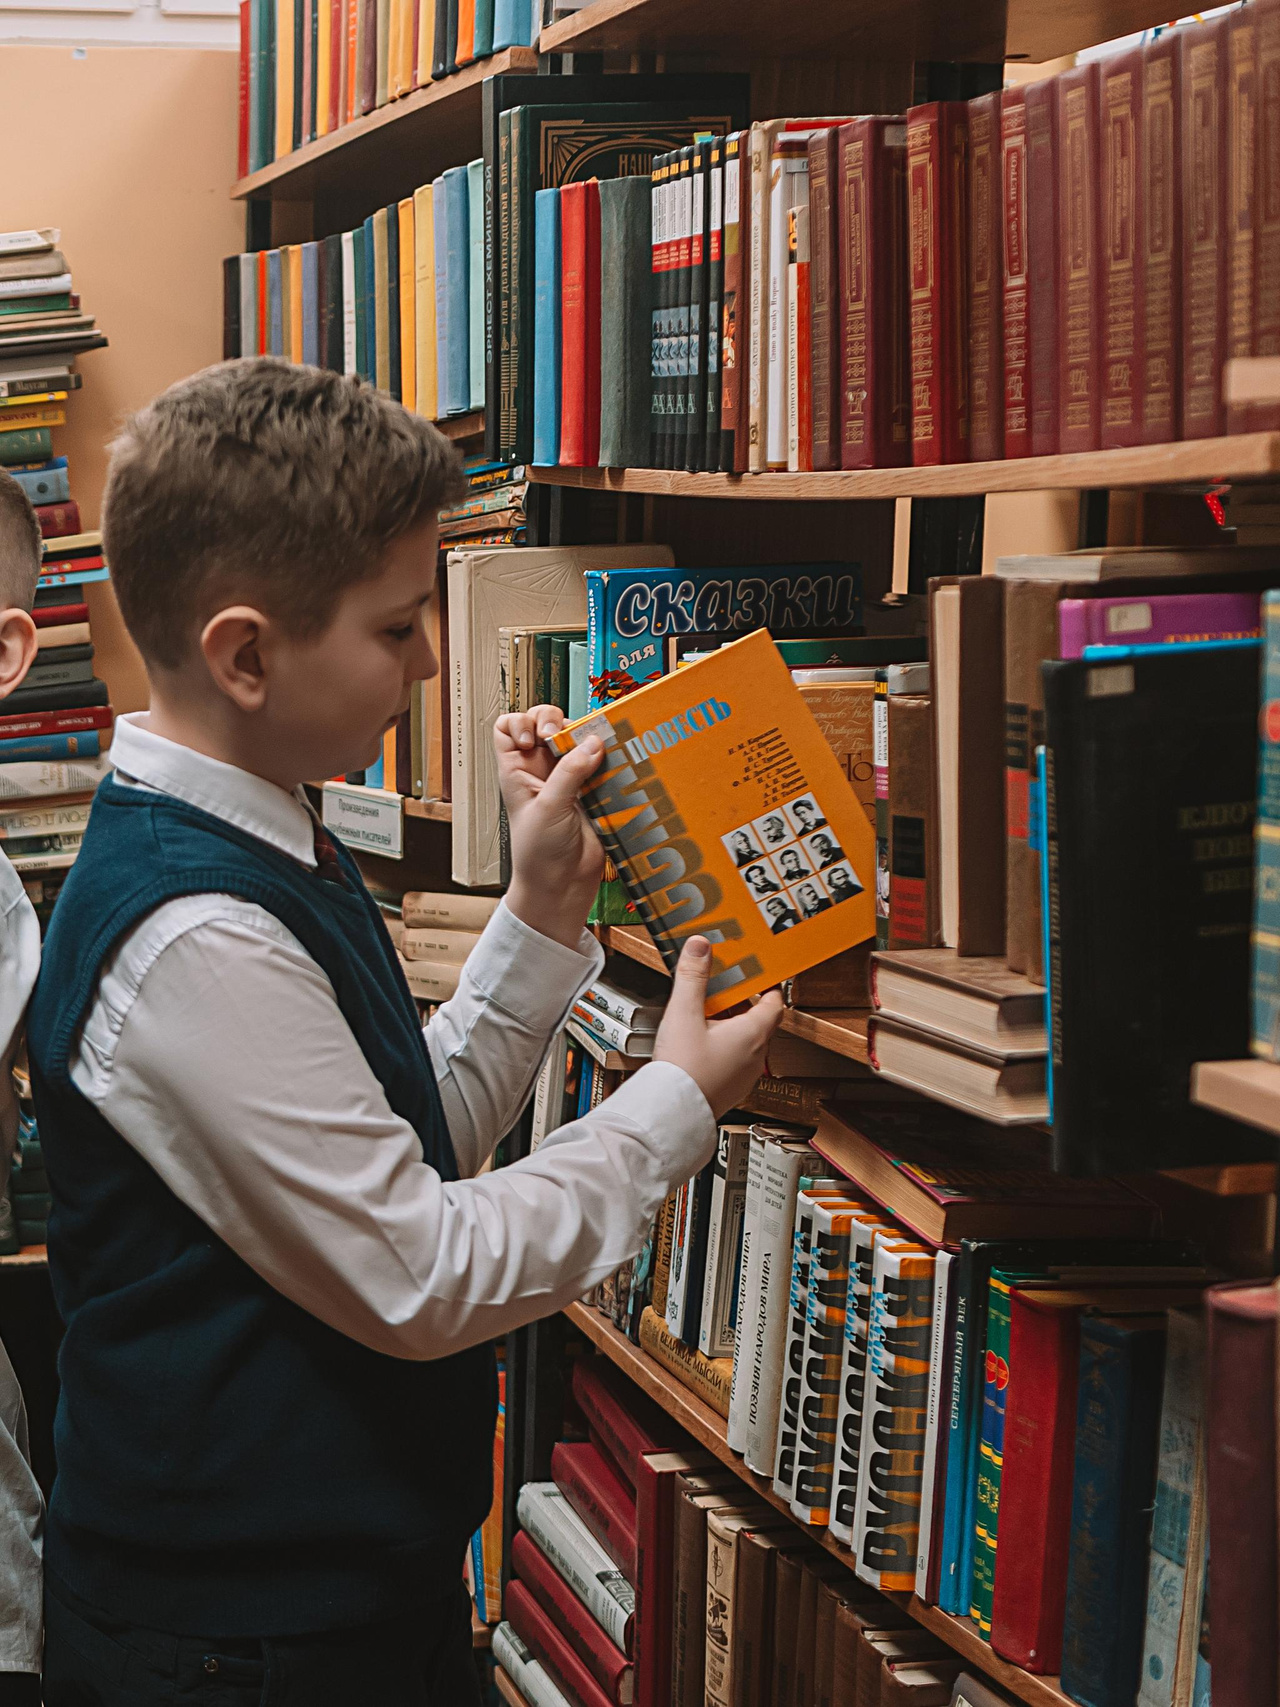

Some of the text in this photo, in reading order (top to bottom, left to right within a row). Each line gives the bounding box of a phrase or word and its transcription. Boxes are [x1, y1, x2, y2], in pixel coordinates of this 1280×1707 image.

[1010, 152, 1018, 200] ПЕТРОВ
[485, 165, 493, 363] ЭРНЕСТ ХЕМИНГУЭЙ
[618, 643, 656, 671] для
[625, 697, 732, 764] ПОВЕСТЬ
[662, 1198, 677, 1266] ВЕЛИКИХ
[735, 1268, 748, 1332] НАРОДОВ
[742, 1231, 752, 1266] МИРА
[692, 1357, 723, 1390] МЫСЛИ
[748, 1252, 772, 1426] ПОЭЗИЯ НАРОДОВ МИРА
[795, 1230, 849, 1508] РУССКАЯ
[950, 1295, 967, 1430] СЕРЕБРЯНЫЙ ВЕК
[862, 1275, 934, 1571] РУССКАЯ
